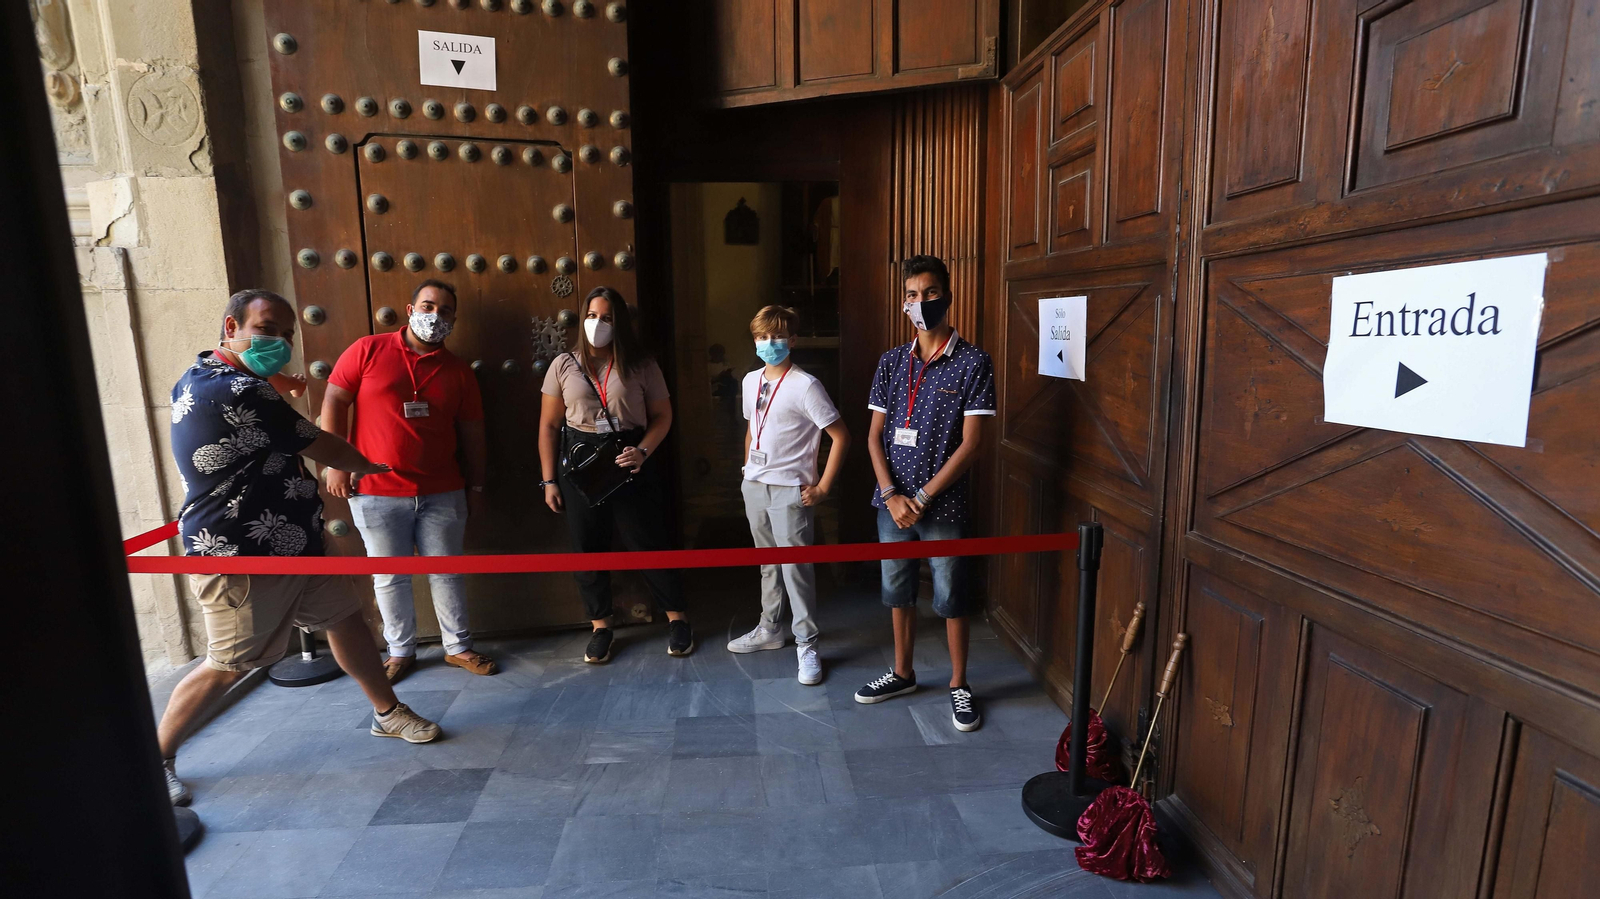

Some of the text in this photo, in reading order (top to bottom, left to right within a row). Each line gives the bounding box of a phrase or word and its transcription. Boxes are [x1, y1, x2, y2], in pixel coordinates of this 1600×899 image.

[433, 40, 482, 54] SALIDA
[1055, 308, 1066, 319] Sólo
[1350, 293, 1501, 337] Entrada
[1050, 325, 1071, 341] Salida
